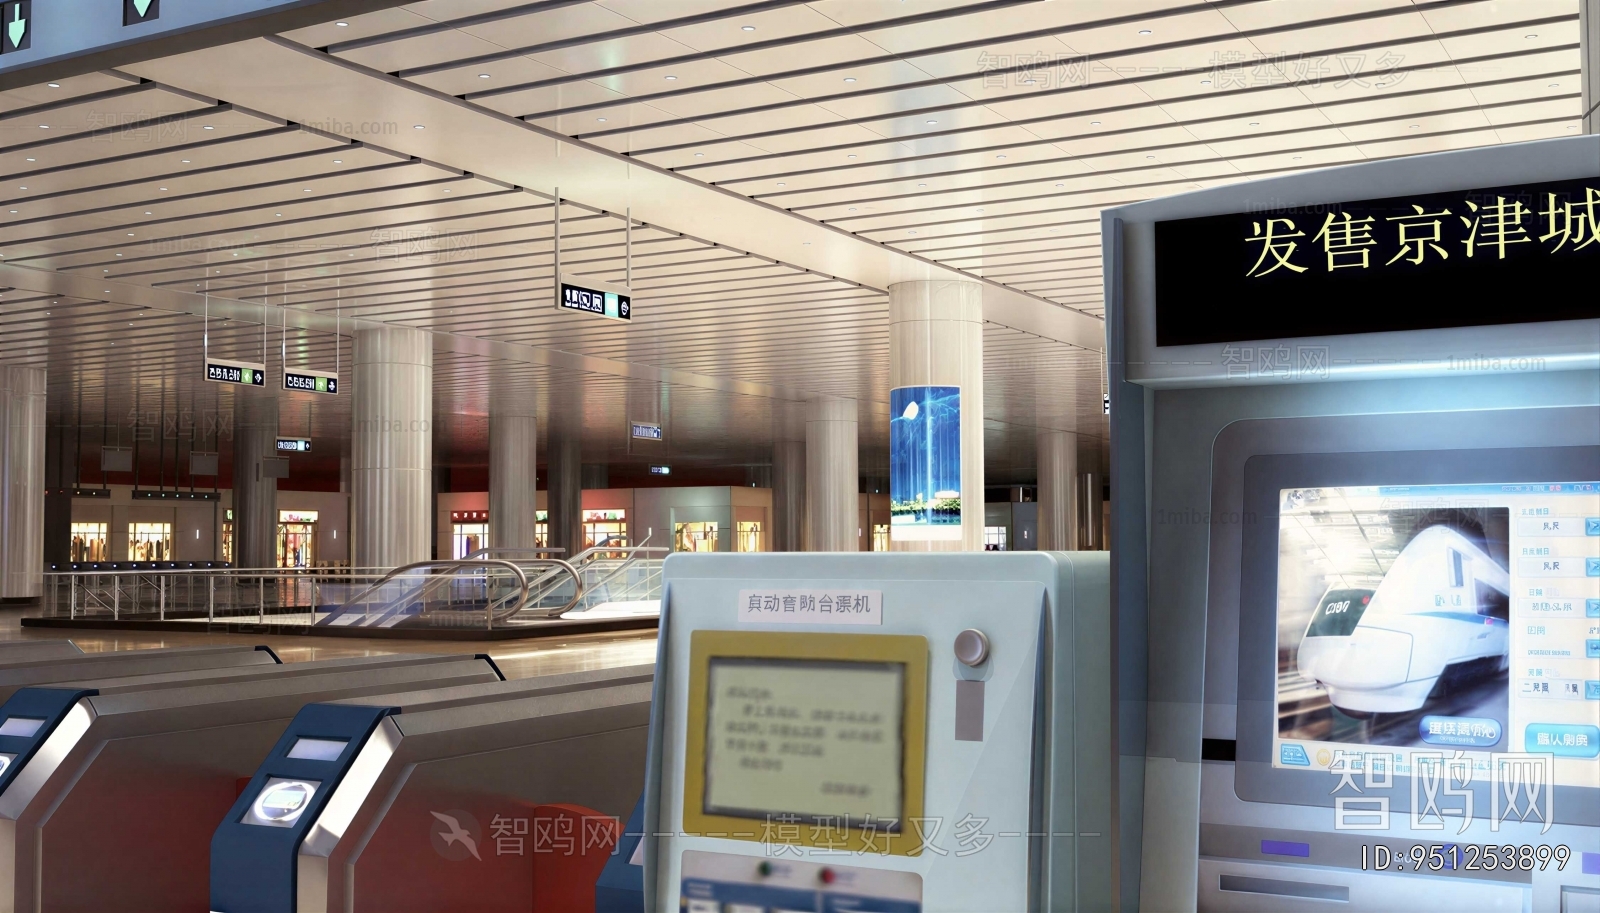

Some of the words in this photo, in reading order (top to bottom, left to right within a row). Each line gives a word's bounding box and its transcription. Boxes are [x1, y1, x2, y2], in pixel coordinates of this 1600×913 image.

[1245, 188, 1600, 278] 发售京津城
